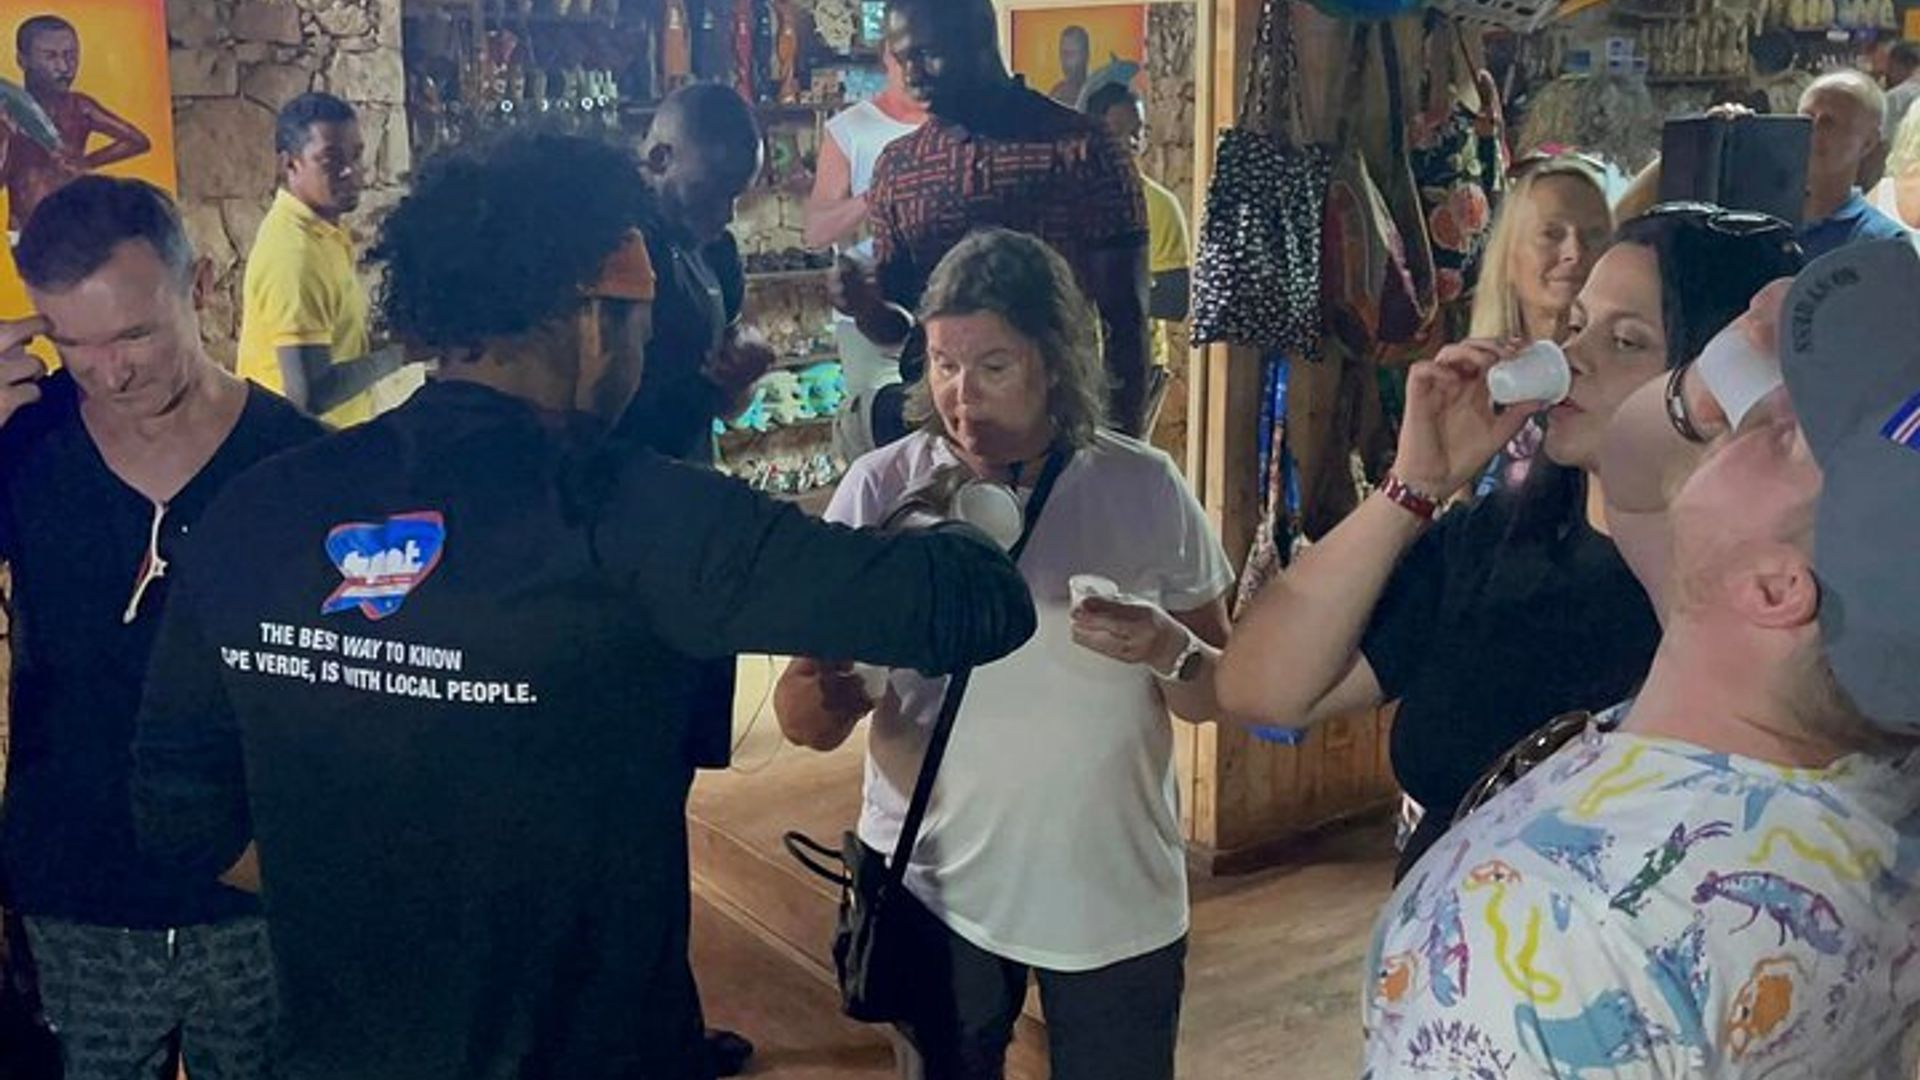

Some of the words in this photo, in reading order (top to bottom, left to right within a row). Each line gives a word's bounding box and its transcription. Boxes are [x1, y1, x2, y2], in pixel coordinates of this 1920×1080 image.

[260, 622, 294, 645] THE
[342, 635, 382, 660] WAY
[386, 641, 405, 664] TO
[408, 643, 462, 671] KNOW
[255, 651, 316, 683] VERDE,
[321, 660, 340, 682] IS
[386, 672, 442, 699] LOCAL
[447, 680, 537, 703] PEOPLE.
